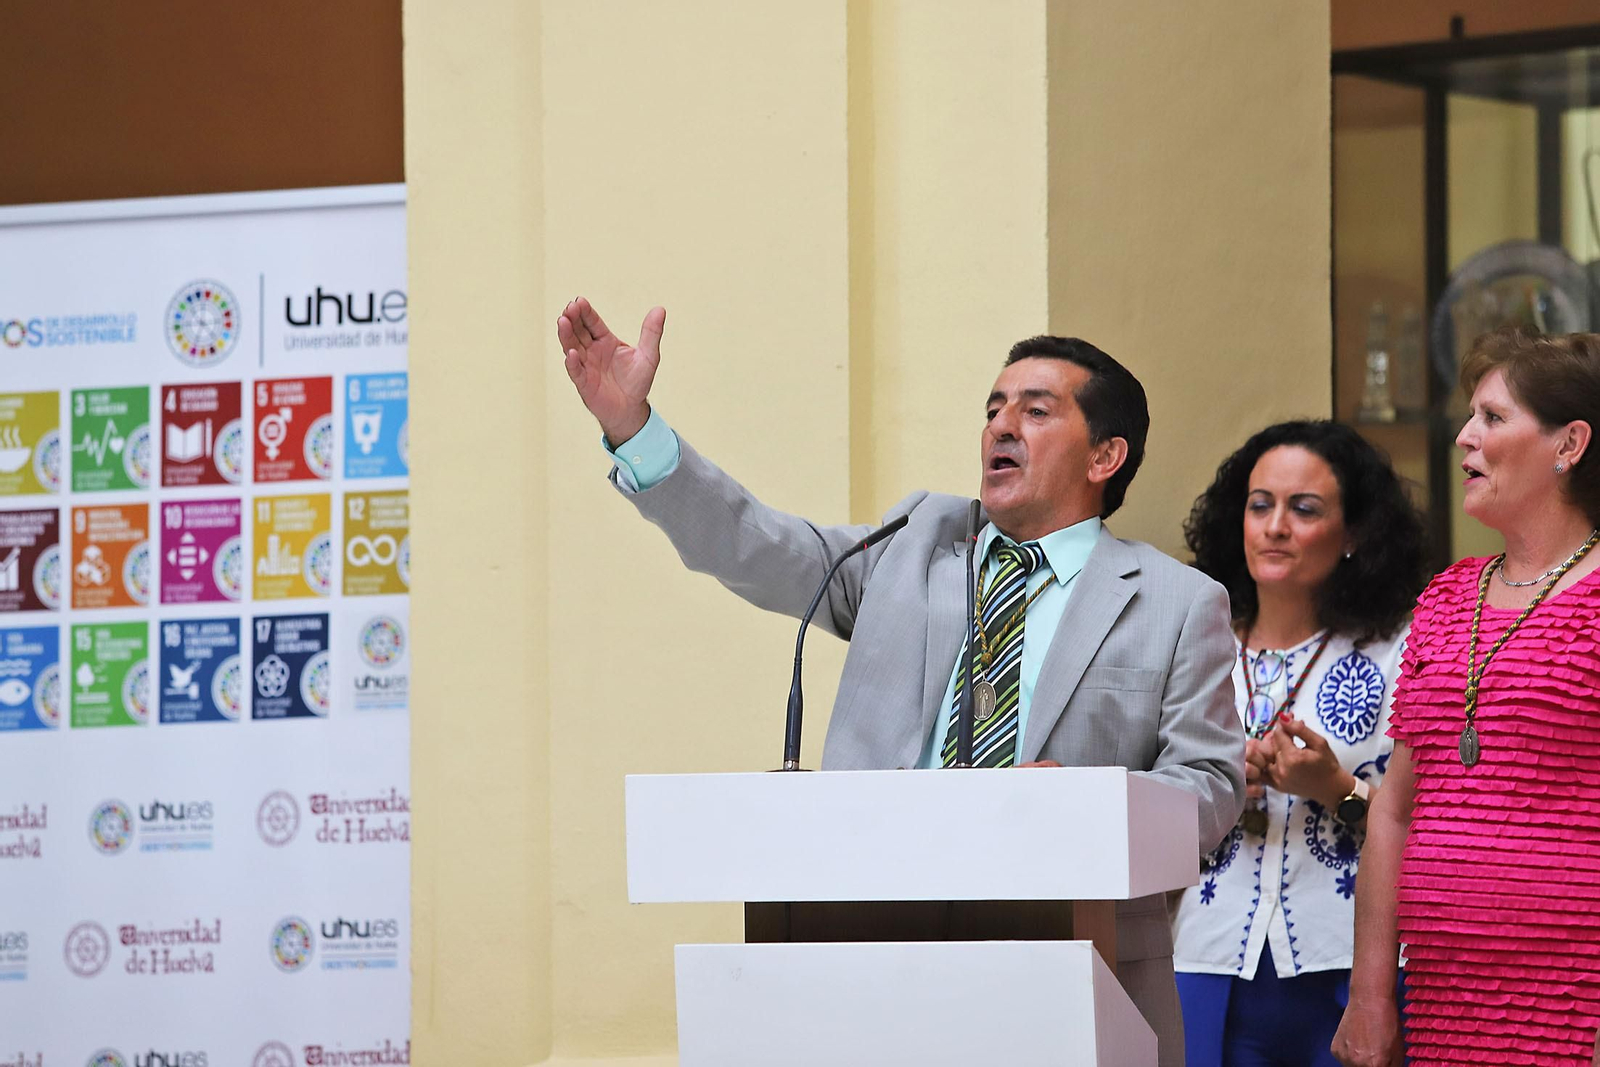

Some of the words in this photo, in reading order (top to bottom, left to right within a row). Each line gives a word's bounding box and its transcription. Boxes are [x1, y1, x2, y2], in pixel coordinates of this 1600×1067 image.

[286, 286, 408, 326] uhu.e
[0, 318, 43, 347] OS
[46, 327, 137, 346] SOSTENIBLE
[283, 333, 361, 351] Universidad
[364, 332, 381, 347] de
[74, 393, 86, 417] 3
[164, 389, 177, 413] 4
[256, 383, 268, 407] 5
[165, 504, 183, 530] 10
[257, 501, 271, 524] 11
[348, 497, 365, 521] 12
[75, 627, 92, 651] 15
[256, 619, 272, 643] 17
[139, 799, 214, 822] uhu.es
[309, 788, 409, 814] Universida
[0, 803, 47, 830] rsidad
[316, 818, 339, 842] de
[118, 918, 221, 945] Universidad
[321, 917, 398, 938] uhu.es
[125, 949, 145, 974] de
[304, 1039, 410, 1066] Universidad
